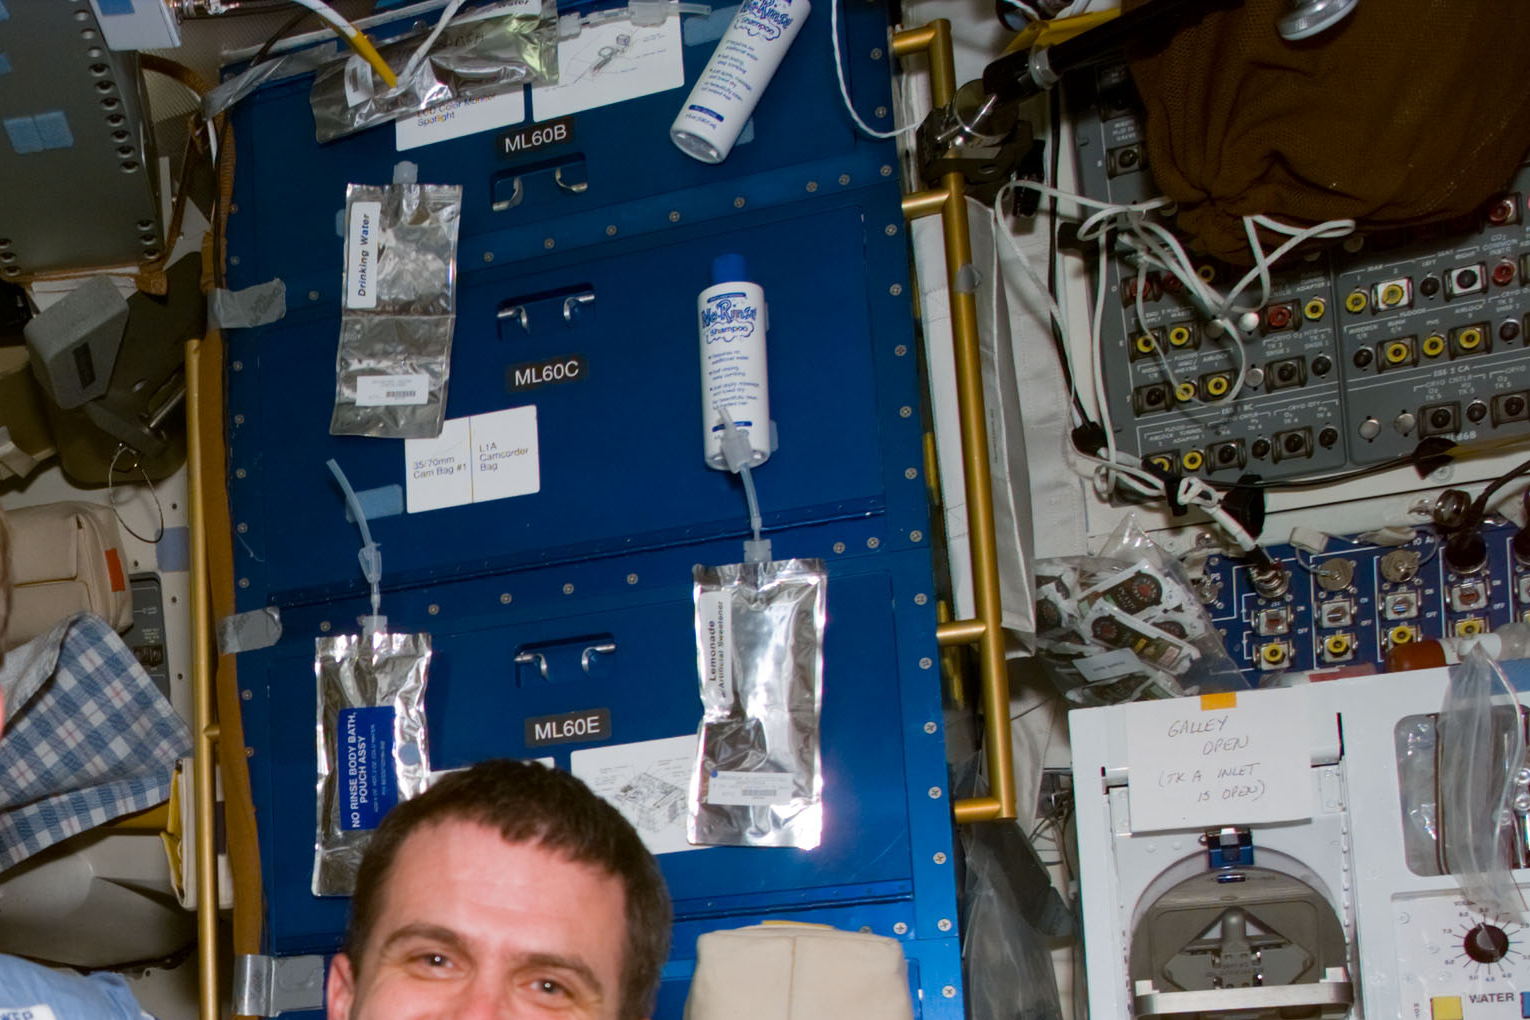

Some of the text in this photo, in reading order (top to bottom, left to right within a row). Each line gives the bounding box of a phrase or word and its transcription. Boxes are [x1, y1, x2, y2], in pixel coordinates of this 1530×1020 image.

[504, 123, 567, 154] ML60B
[357, 214, 372, 297] Drinking Water
[514, 360, 580, 387] ML60C
[479, 447, 529, 462] Camcorder
[413, 463, 468, 479] Cam Bag #1
[480, 462, 499, 473] Bag
[707, 620, 717, 682] Lemonade
[534, 716, 601, 740] ML60E
[1168, 716, 1228, 737] GALLEY
[1202, 735, 1250, 755] OPEN
[348, 746, 358, 776] BODY
[357, 736, 368, 804] POUCH ASSY
[1217, 762, 1262, 779] INLET
[349, 777, 359, 810] RINSE
[351, 811, 361, 828] NO
[1469, 991, 1515, 1004] WATER
